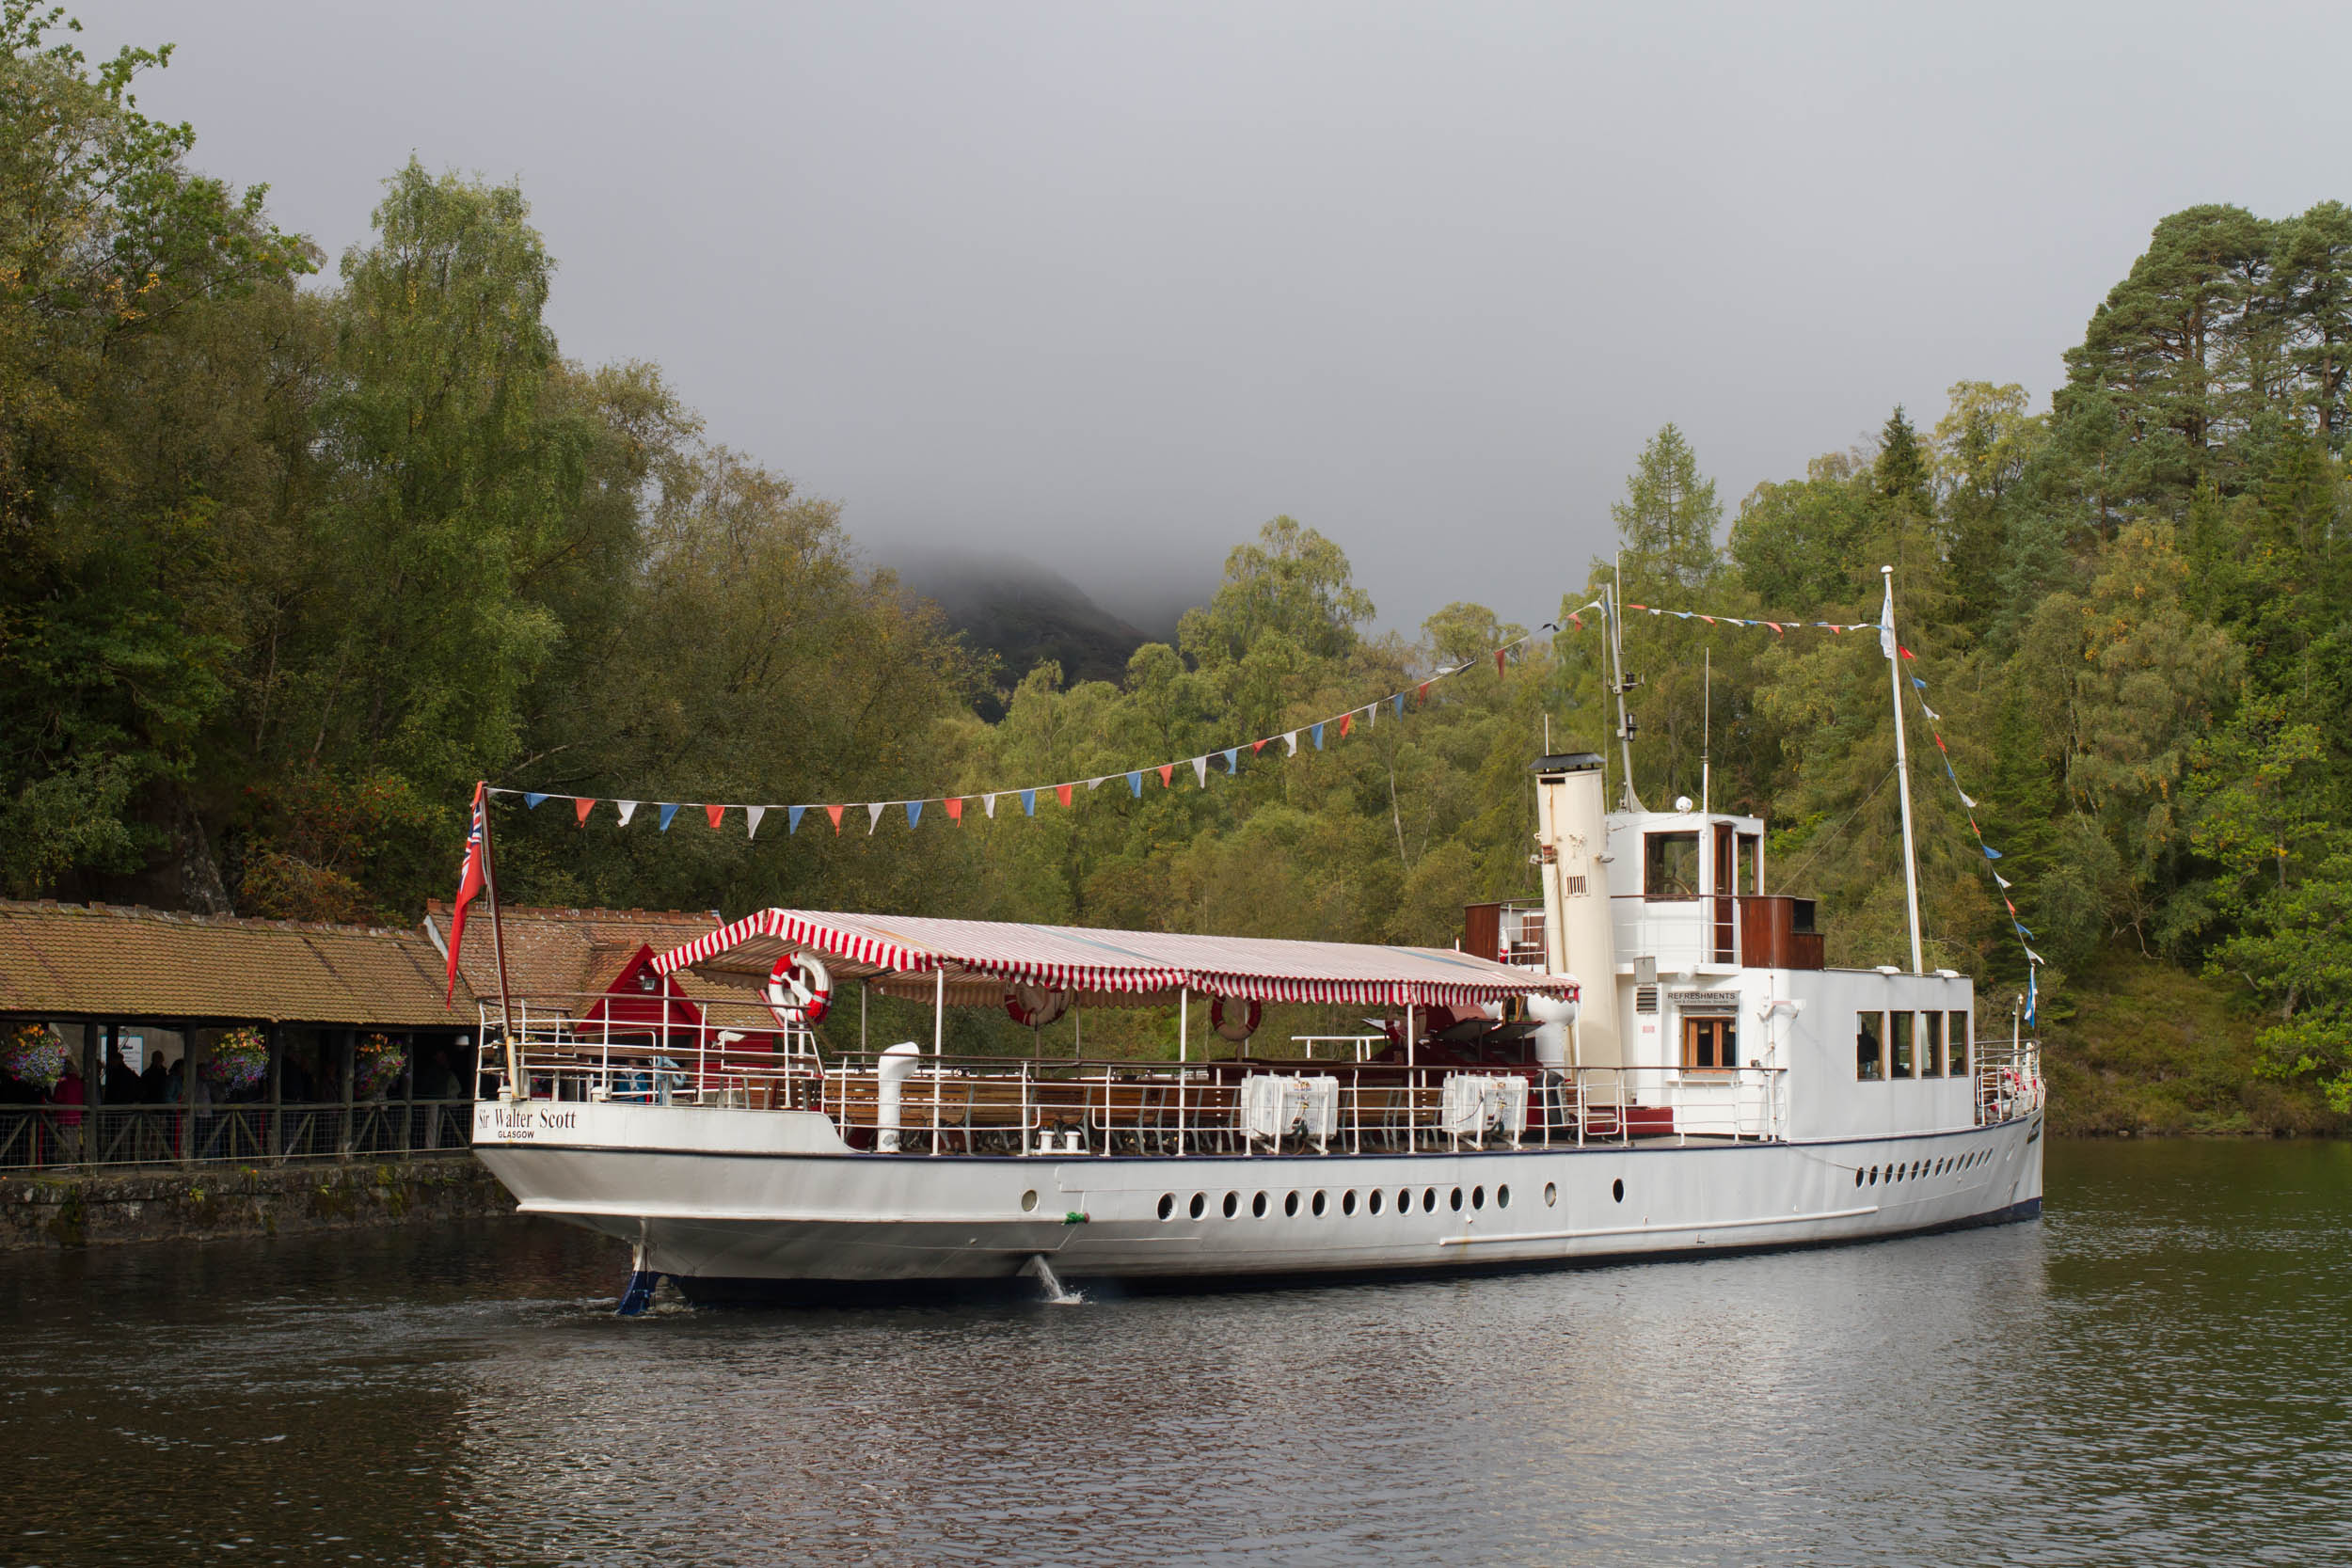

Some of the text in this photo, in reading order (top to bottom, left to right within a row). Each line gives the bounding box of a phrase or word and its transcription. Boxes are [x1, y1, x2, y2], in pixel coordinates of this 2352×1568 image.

[478, 1107, 577, 1129] Sir Walter Scott
[498, 1131, 535, 1139] GLASGOW
